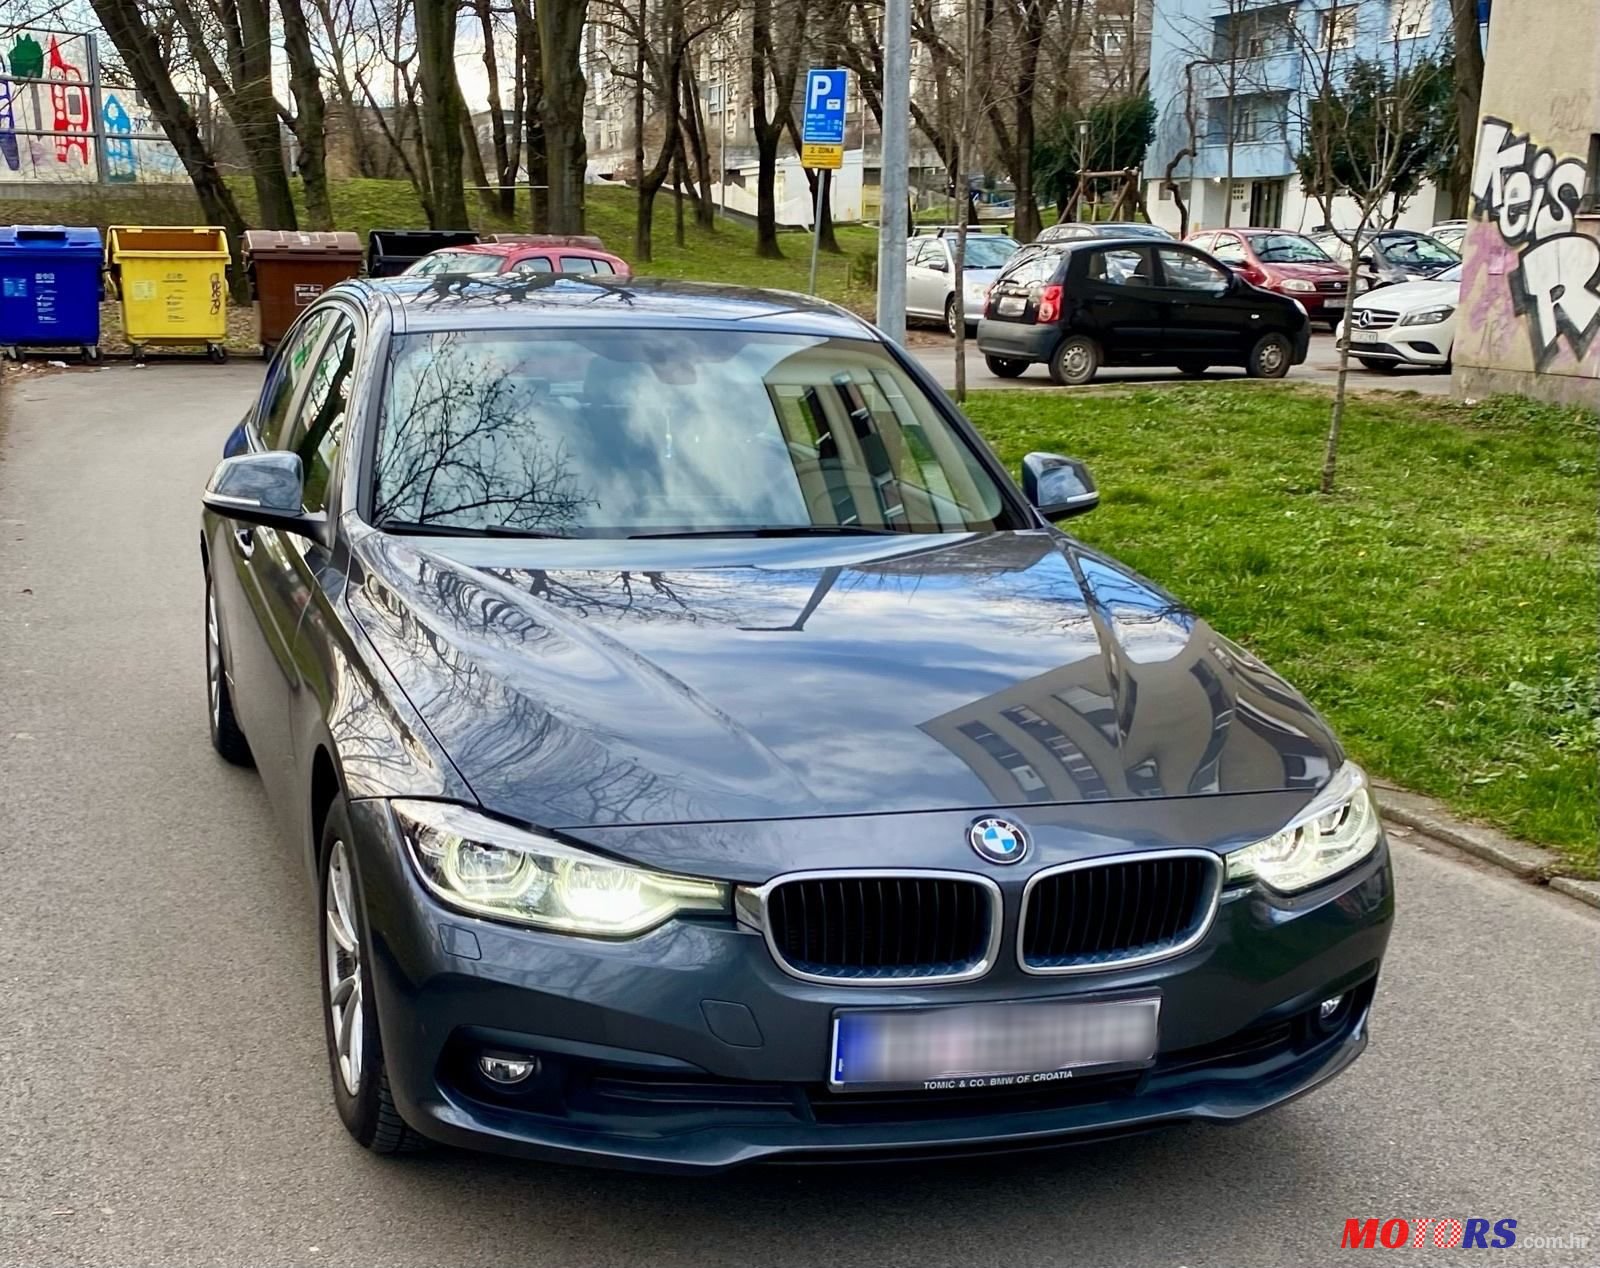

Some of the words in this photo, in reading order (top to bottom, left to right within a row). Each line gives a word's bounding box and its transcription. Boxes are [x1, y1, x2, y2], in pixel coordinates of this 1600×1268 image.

[810, 75, 832, 110] P
[923, 1081, 955, 1090] TOMIC
[959, 1080, 966, 1088] &
[990, 1076, 1014, 1086] BMW
[1016, 1074, 1031, 1084] OF
[1033, 1070, 1073, 1082] CROATIA
